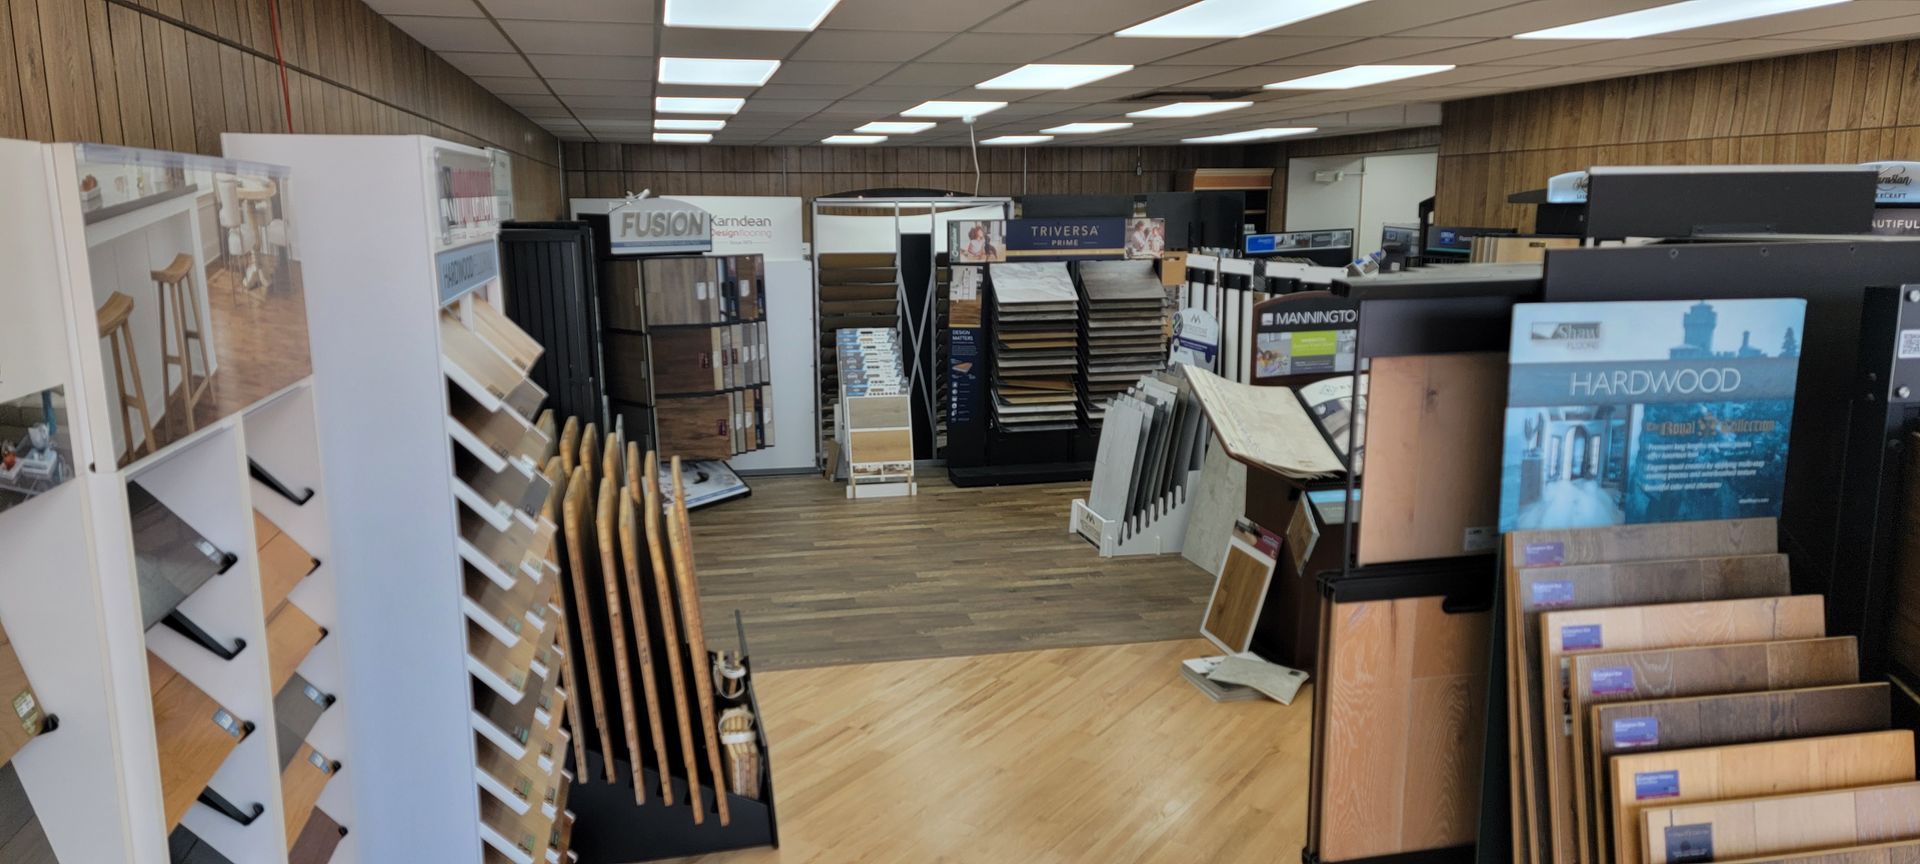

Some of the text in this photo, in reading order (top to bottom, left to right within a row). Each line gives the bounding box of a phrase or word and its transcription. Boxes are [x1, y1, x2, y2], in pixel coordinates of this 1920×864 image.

[620, 211, 704, 238] FUSION
[710, 215, 772, 227] Karndean
[1031, 225, 1098, 237] TRIVERSA
[1051, 239, 1079, 247] PRIME
[1275, 309, 1359, 325] MANNINGTO
[1559, 323, 1600, 339] Shaw
[1570, 367, 1742, 396] HARDWOOD
[1661, 421, 1696, 436] Royal
